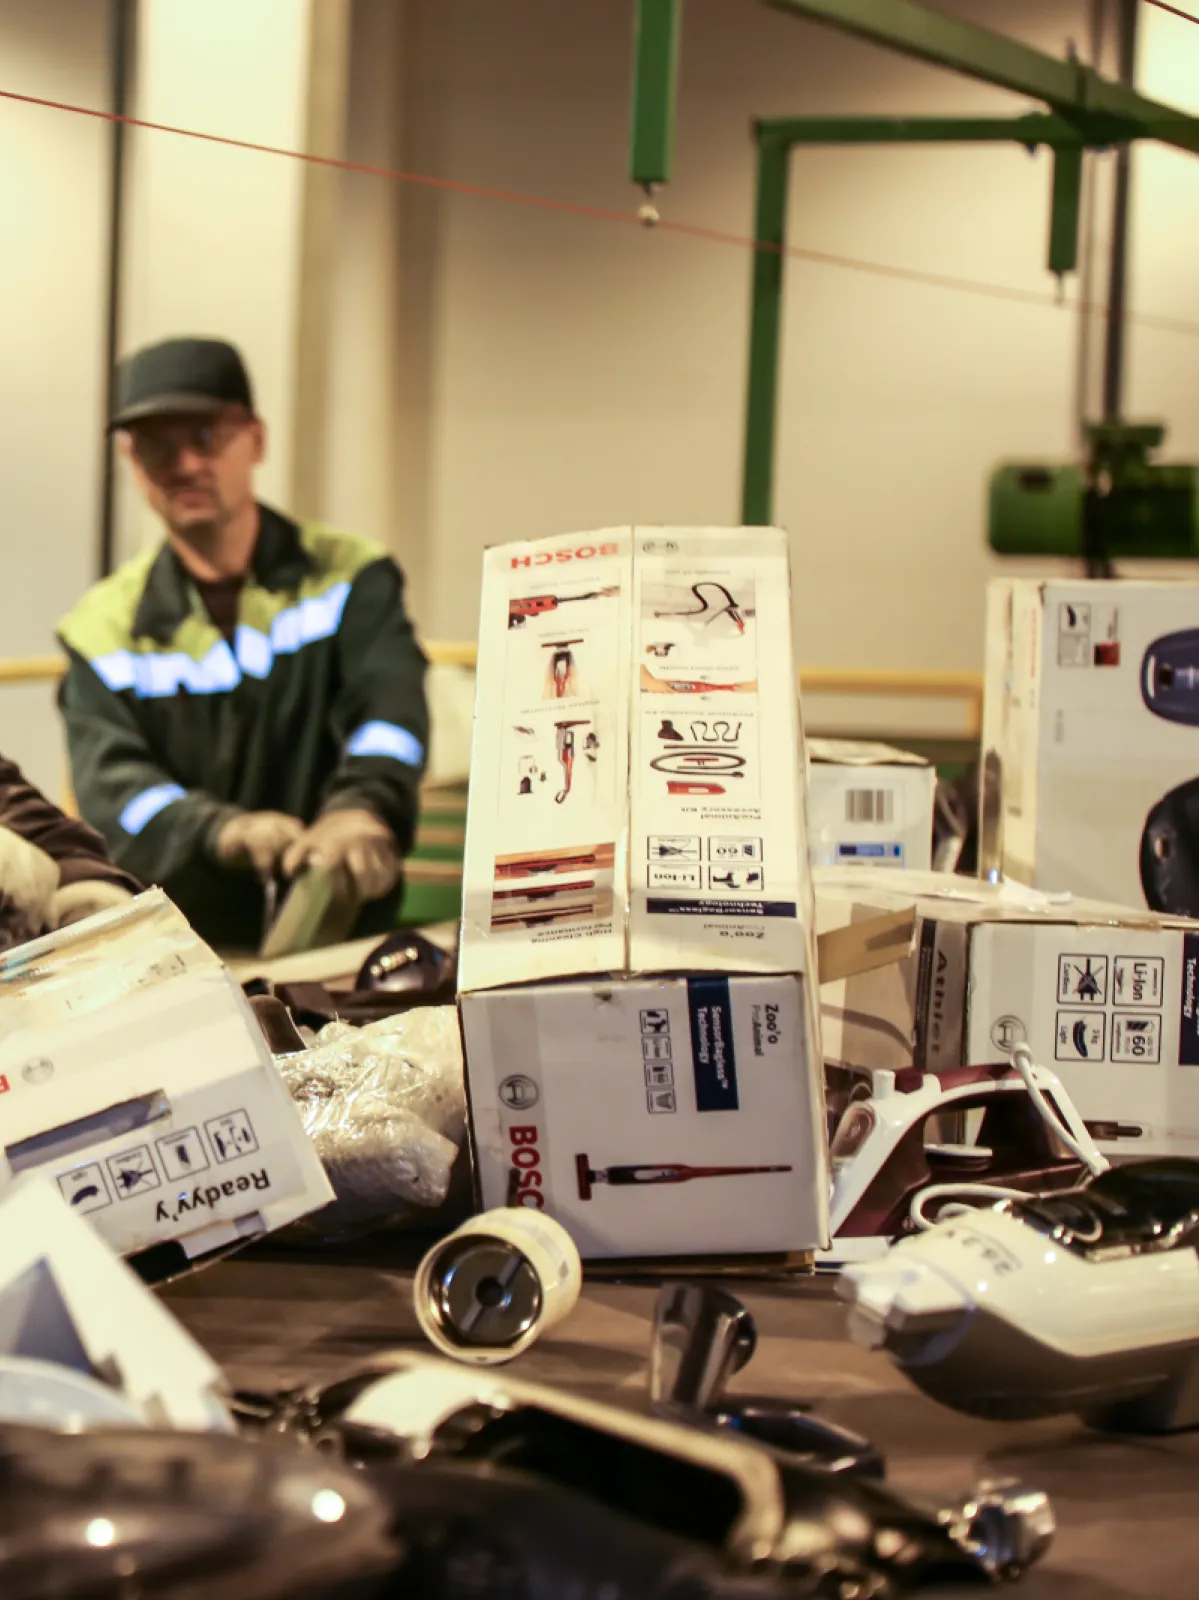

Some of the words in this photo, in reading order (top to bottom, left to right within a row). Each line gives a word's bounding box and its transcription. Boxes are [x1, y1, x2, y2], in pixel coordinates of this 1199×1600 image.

[511, 542, 619, 569] BOSCH
[931, 949, 948, 1055] Athlet
[1133, 962, 1148, 1000] Li-Ion
[1183, 957, 1197, 1019] Technology
[697, 1006, 711, 1064] Technology
[764, 1003, 780, 1044] Zoo'o
[1132, 1035, 1146, 1056] 60
[509, 1125, 545, 1209] BOSC
